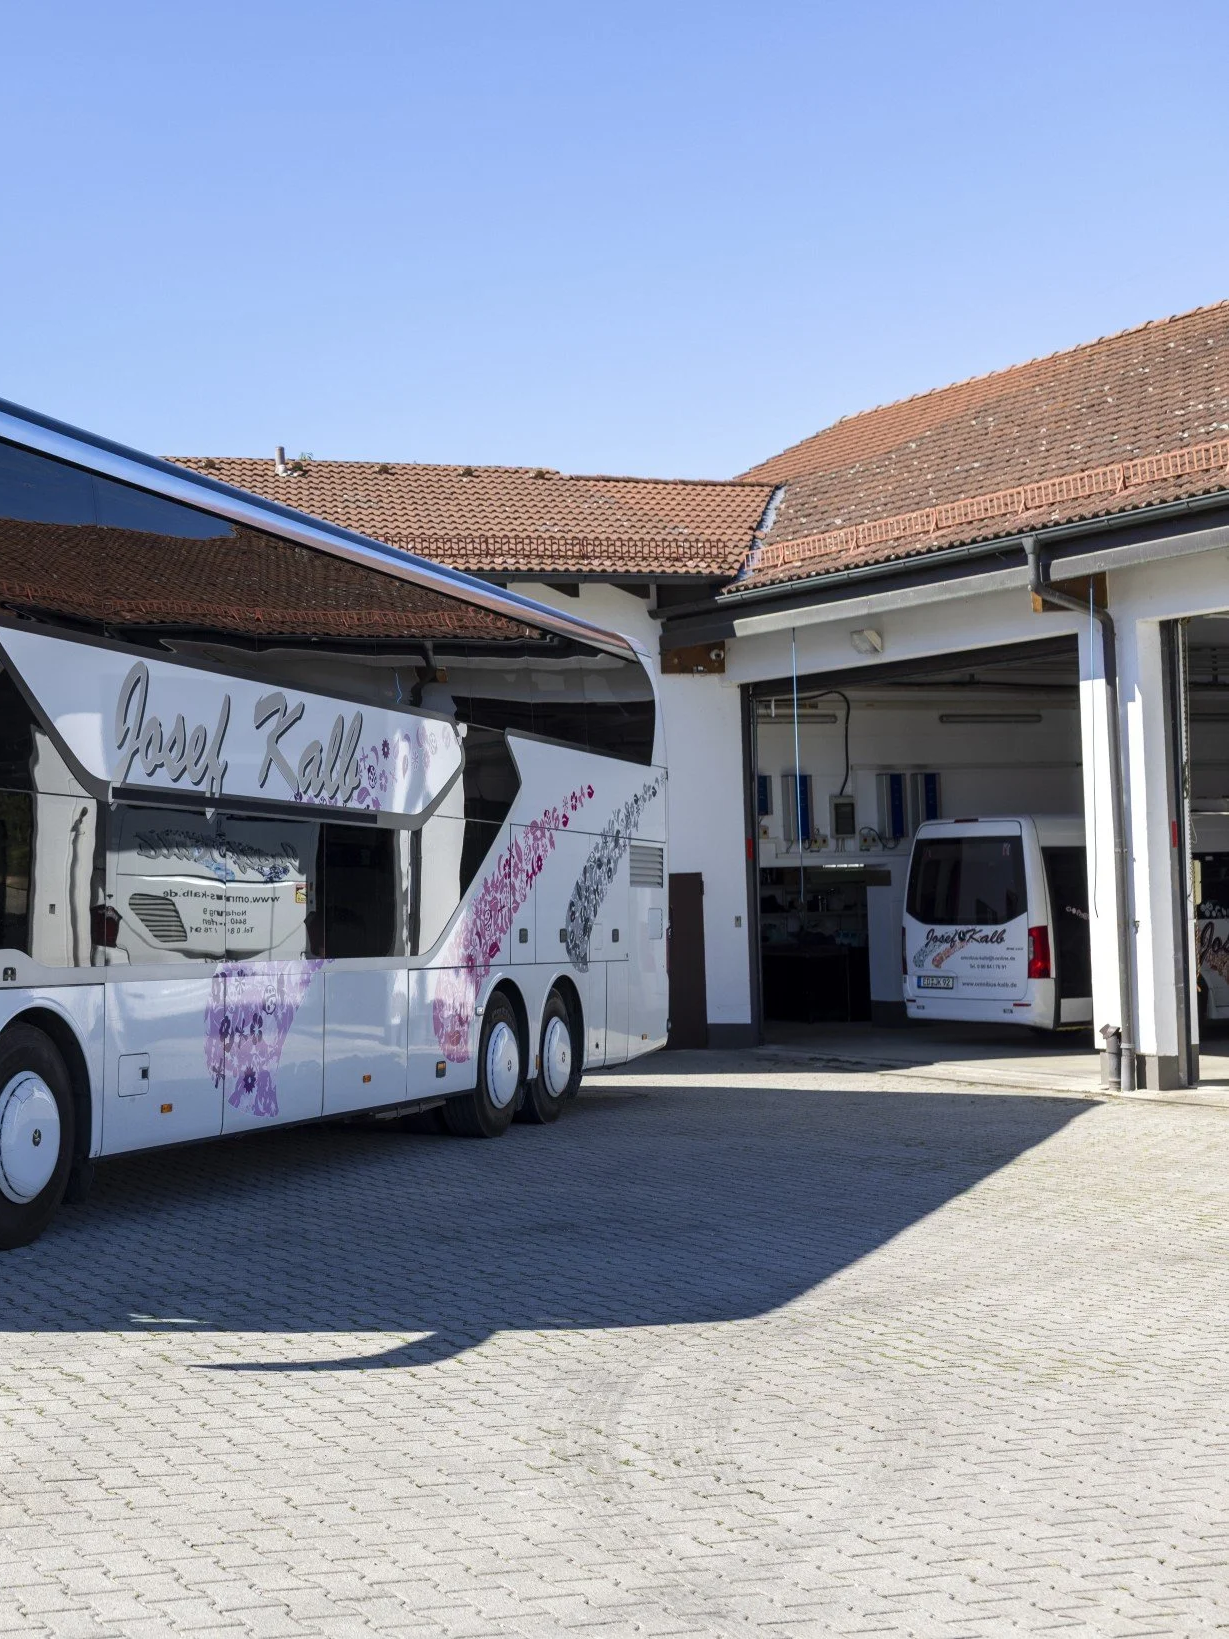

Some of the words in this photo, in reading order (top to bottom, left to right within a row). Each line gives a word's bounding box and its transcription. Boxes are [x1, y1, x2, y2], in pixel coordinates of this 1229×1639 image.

[108, 660, 230, 823] Josef
[254, 691, 363, 804] Kalb
[924, 928, 958, 949] Josef
[965, 928, 1007, 945] Kalb
